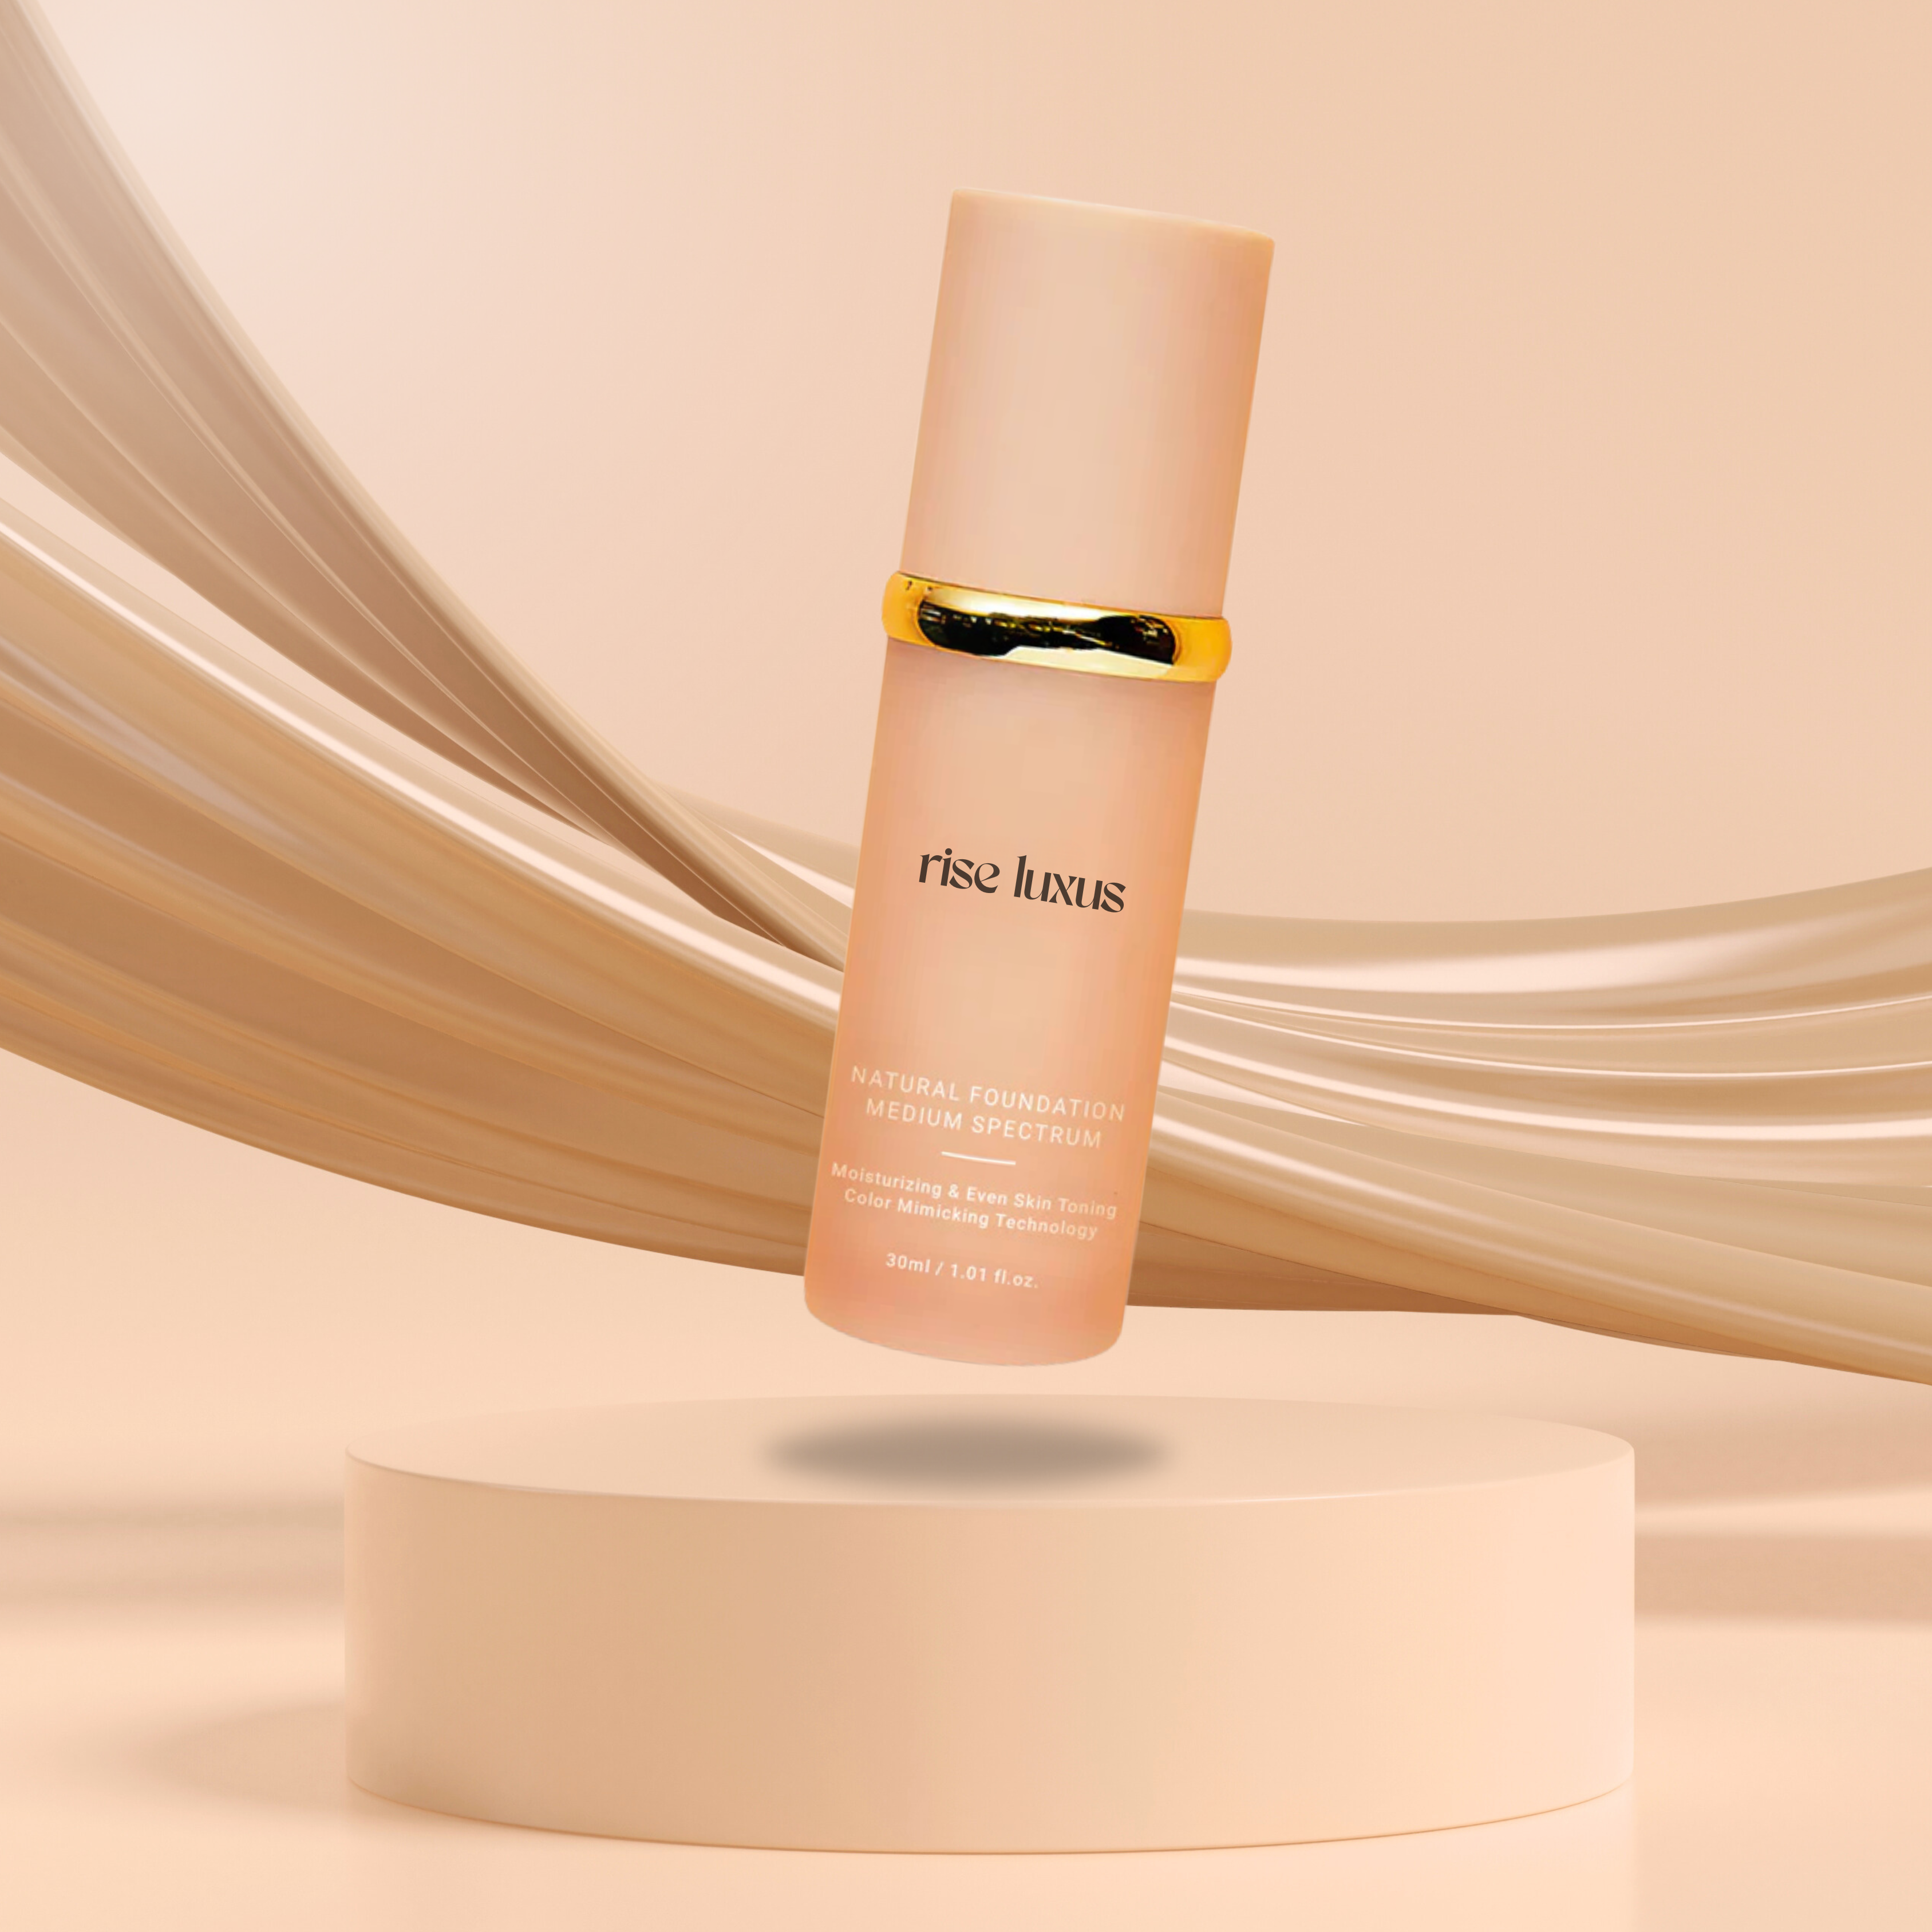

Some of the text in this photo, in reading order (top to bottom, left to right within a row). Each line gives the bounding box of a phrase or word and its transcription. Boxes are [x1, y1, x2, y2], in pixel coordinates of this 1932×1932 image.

[919, 848, 1126, 912] rise luxus
[851, 1066, 1125, 1121] NATURAL FOUNDATION
[866, 1099, 1102, 1148] MEDIUM SPECTRUM
[831, 1163, 1117, 1219] Moisturizing & Even Skin Toning
[844, 1189, 1098, 1240] Color Mimicking Technology
[886, 1253, 1038, 1288] 30ml / 1.01 fl.oz.
